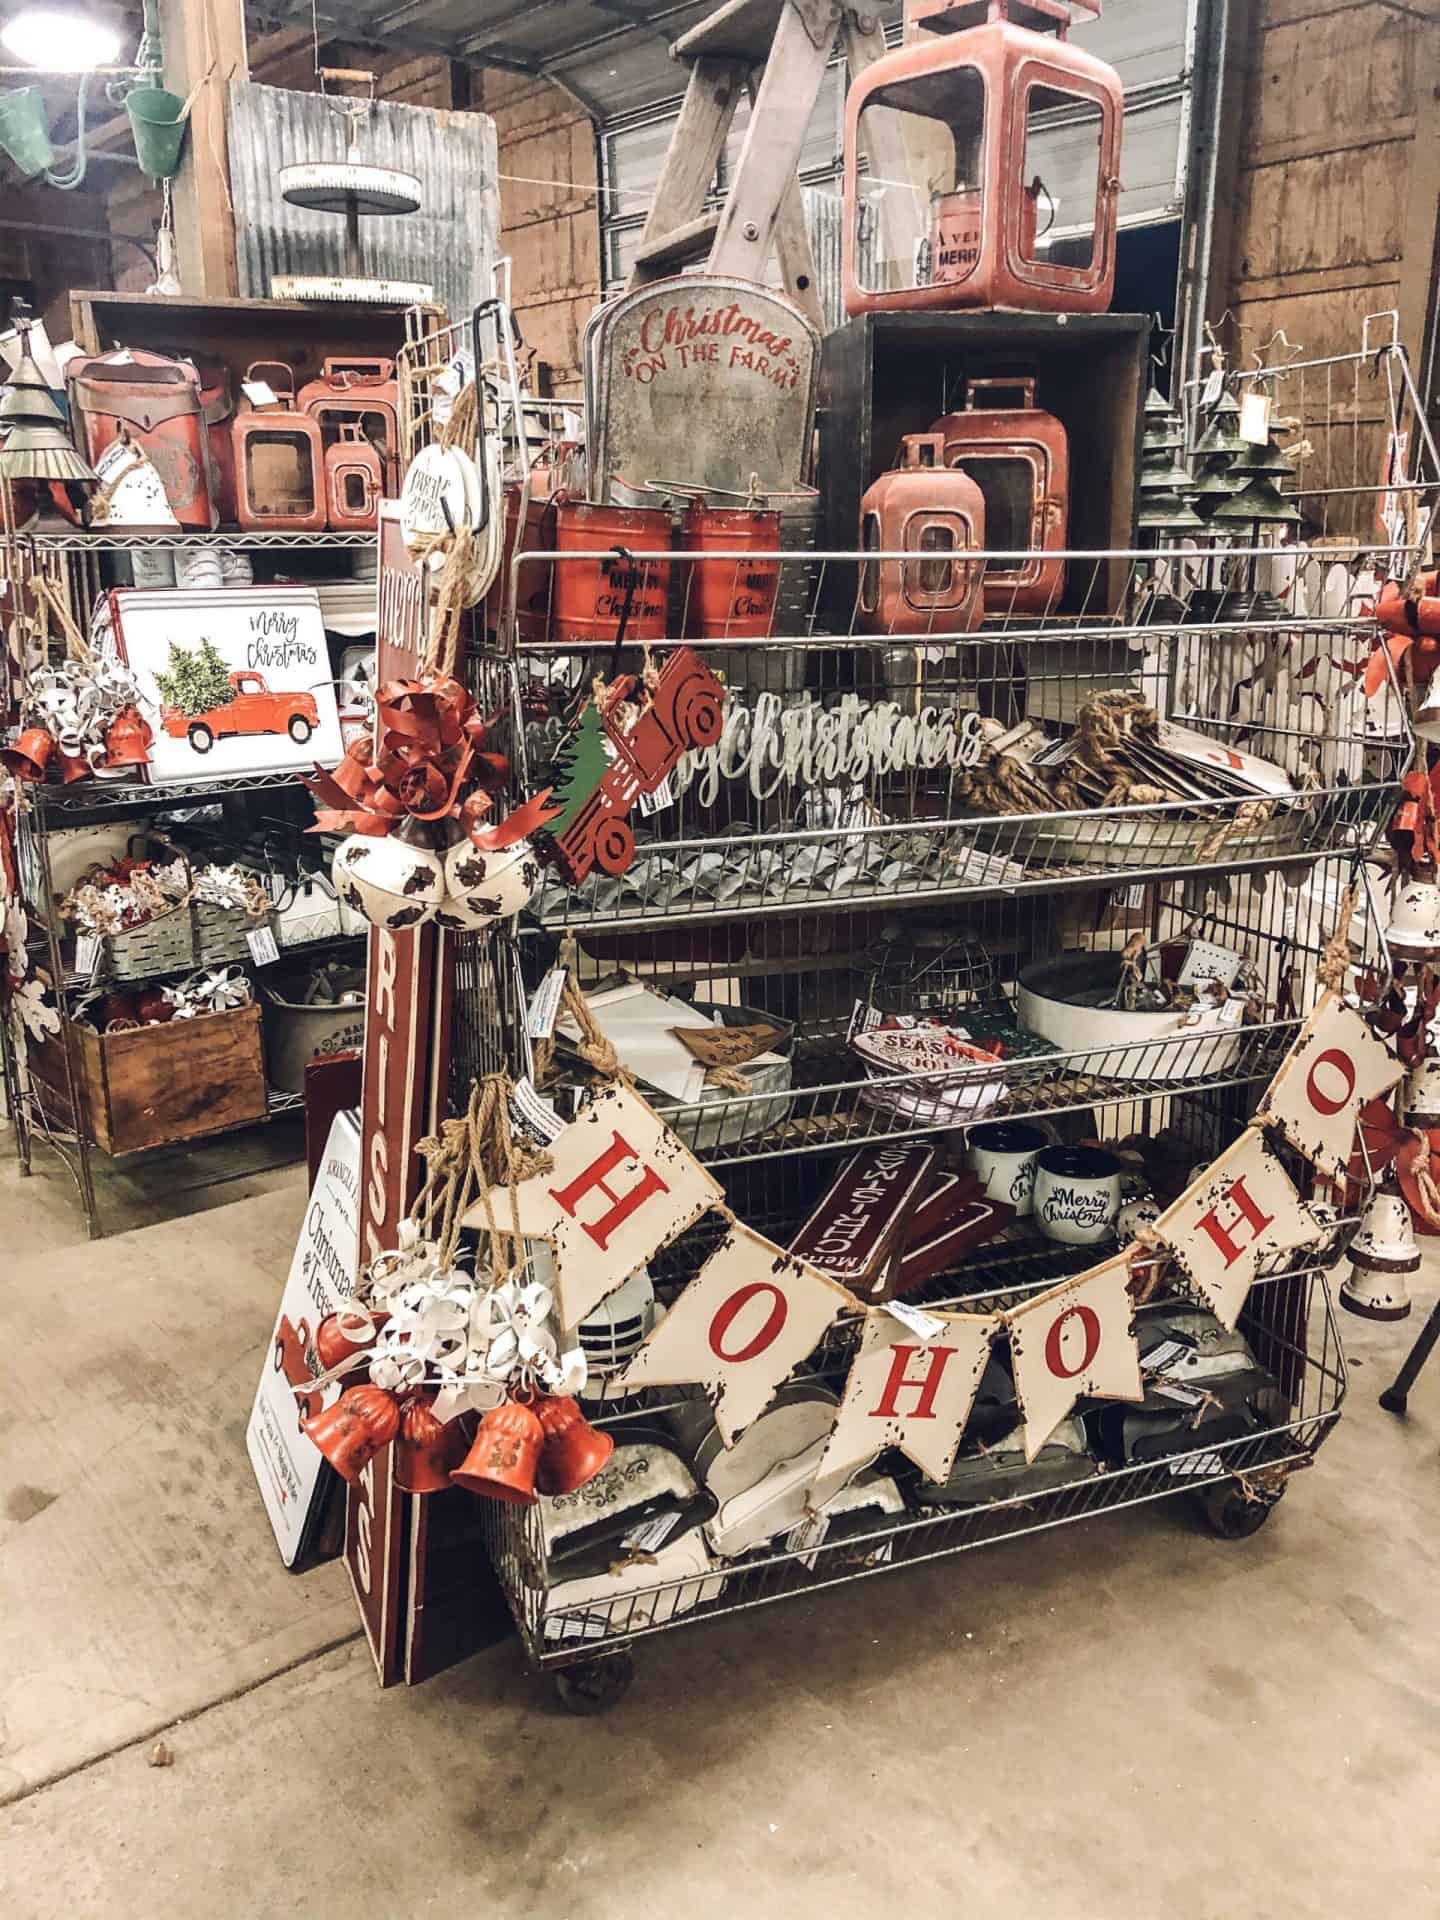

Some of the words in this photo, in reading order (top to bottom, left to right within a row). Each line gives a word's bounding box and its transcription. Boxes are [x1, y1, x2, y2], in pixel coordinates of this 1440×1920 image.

[640, 303, 792, 357] Christmas
[636, 353, 667, 384] ON
[676, 343, 720, 369] THE
[729, 346, 789, 389] FARM
[250, 611, 300, 643] Merry
[247, 636, 318, 669] Christmas
[1043, 1197, 1114, 1229] Christmas
[1057, 1187, 1109, 1210] Merry
[548, 1129, 671, 1252] H
[708, 1282, 788, 1363] O
[868, 1344, 958, 1419] H
[1044, 1305, 1101, 1379] O
[1193, 1174, 1275, 1270] H
[1306, 1048, 1356, 1116] O
